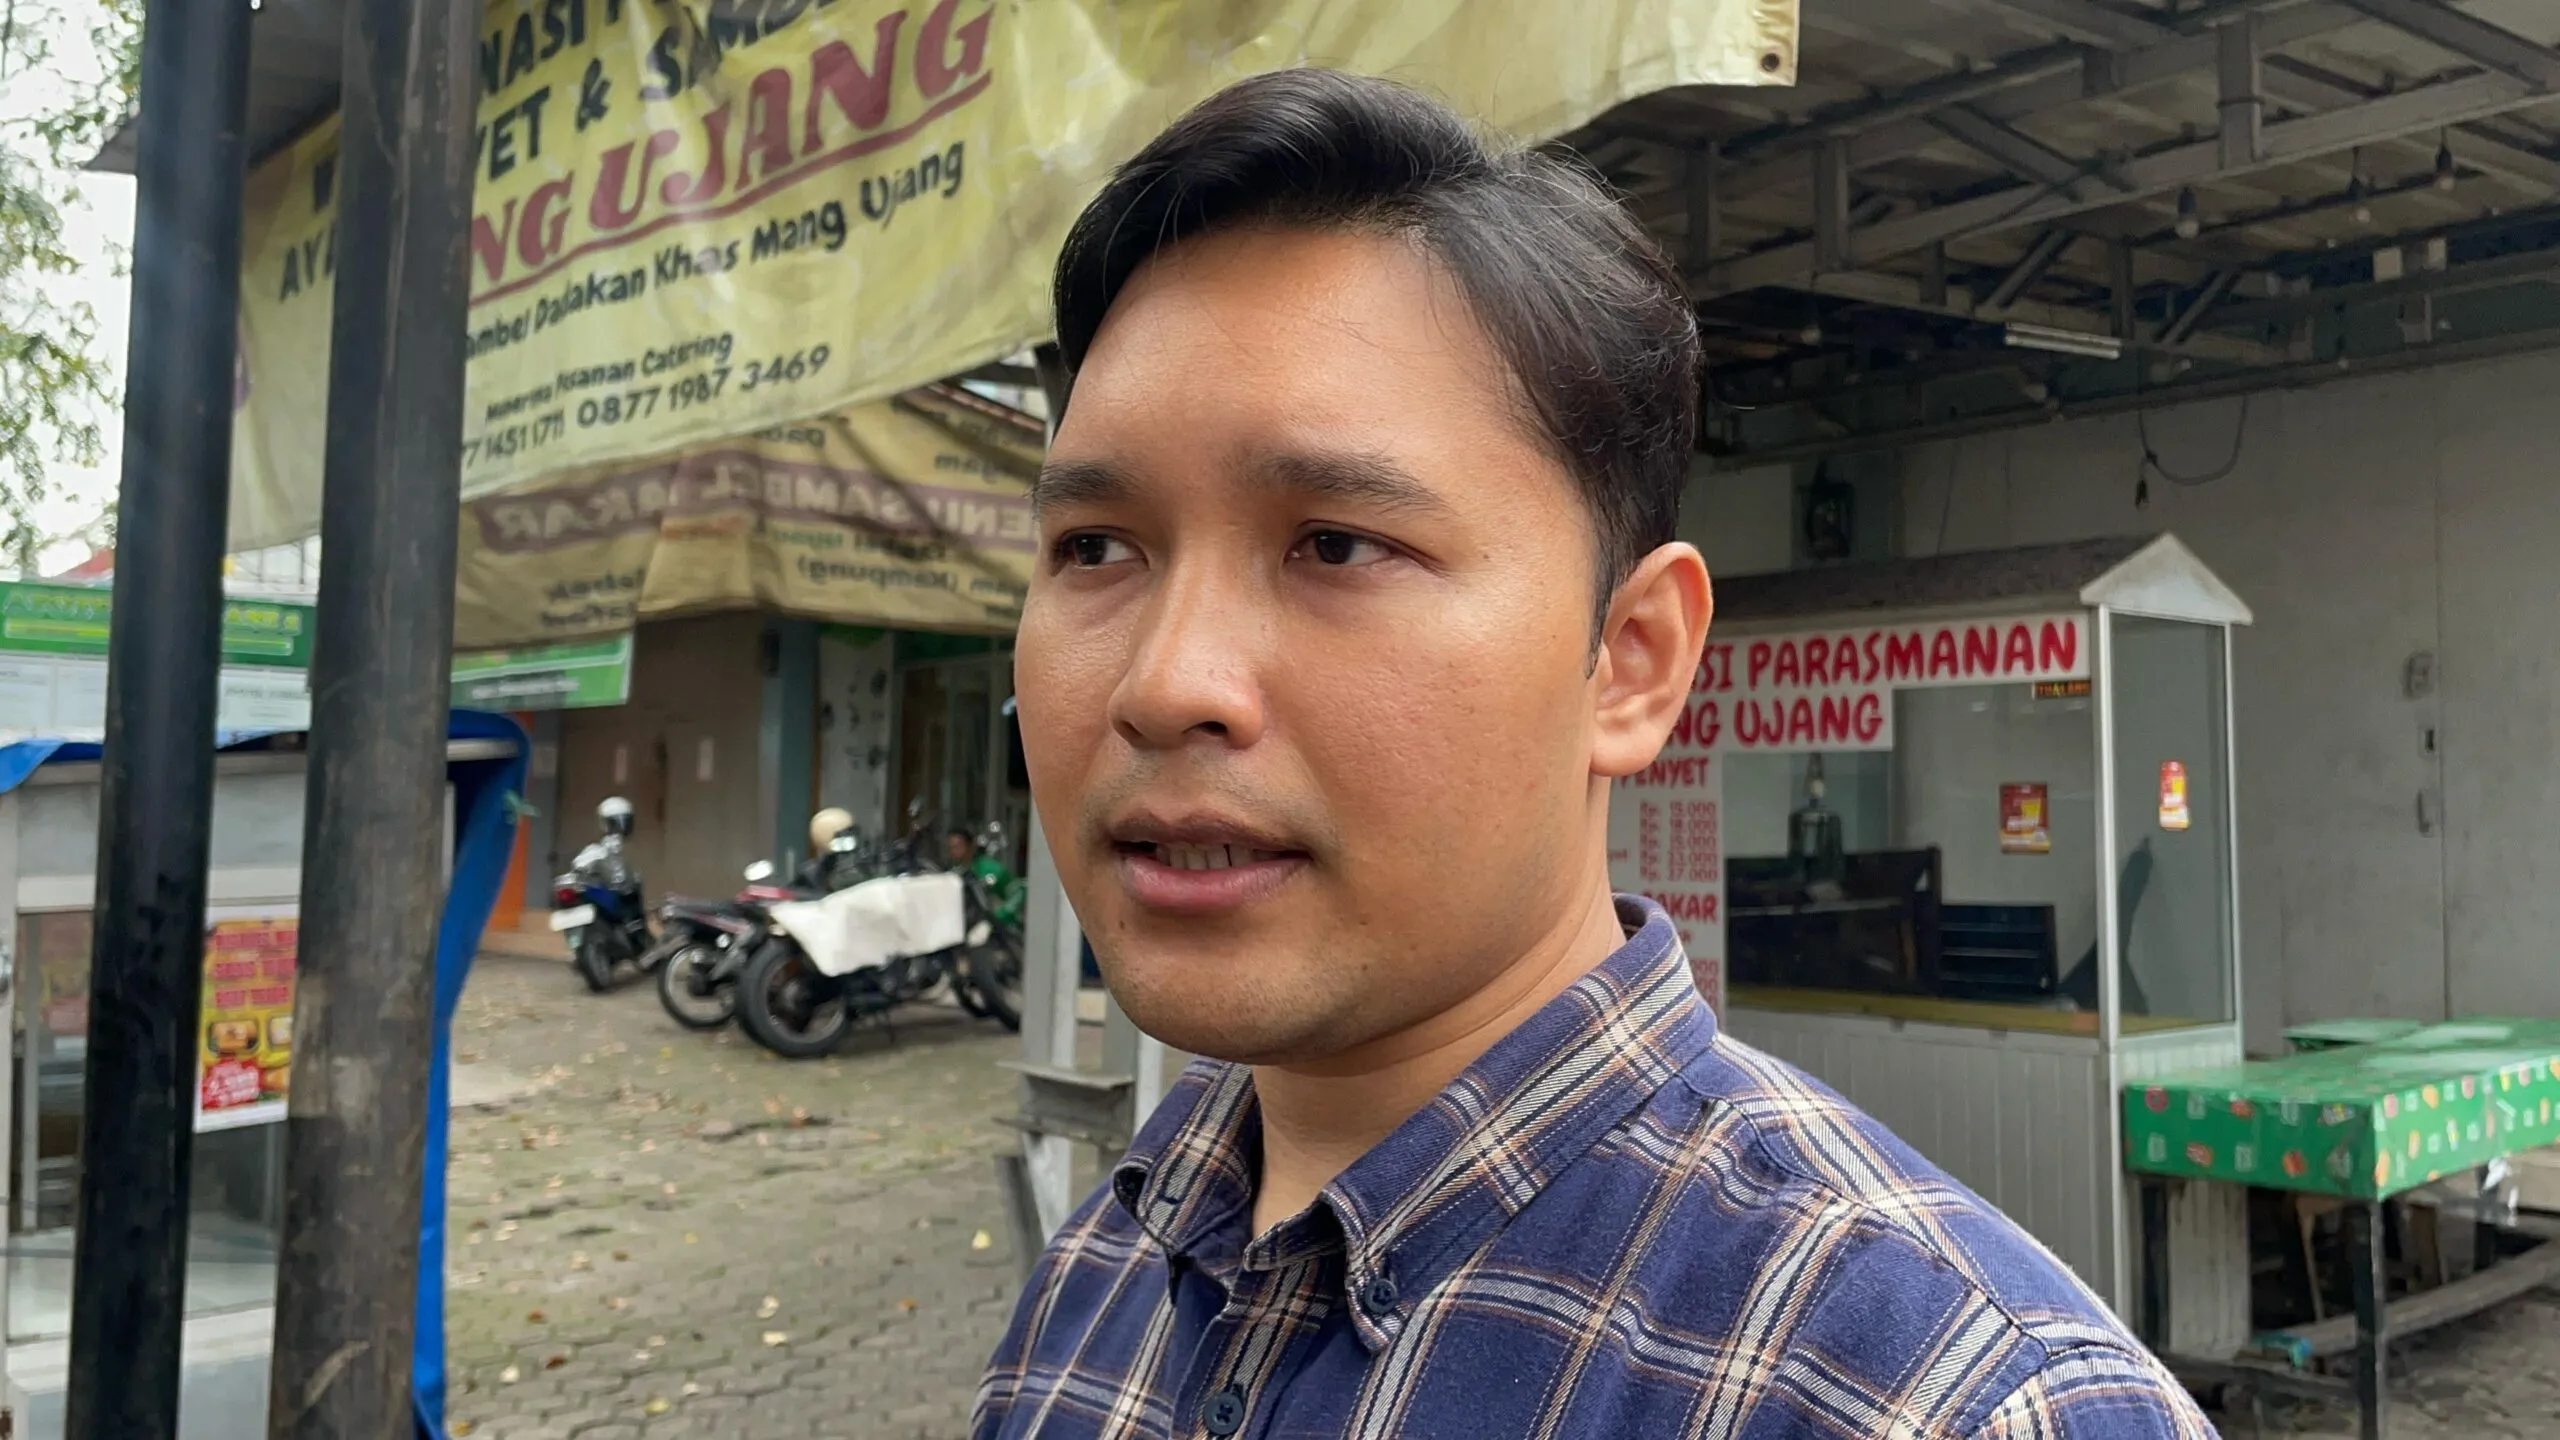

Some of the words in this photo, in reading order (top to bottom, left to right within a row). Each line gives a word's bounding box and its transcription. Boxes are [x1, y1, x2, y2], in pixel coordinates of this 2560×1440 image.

[577, 57, 612, 133] &
[471, 170, 575, 282] NG
[588, 0, 995, 230] UJANG
[654, 241, 740, 290] Khas
[751, 200, 847, 265] Mang
[860, 141, 965, 233] Ujang
[577, 385, 662, 429] 0877
[740, 342, 831, 393] 3469
[641, 331, 734, 377] Catering
[1747, 619, 2077, 691] PARASMANAN
[1667, 699, 1721, 748] NG
[1733, 692, 1884, 748] UJANG
